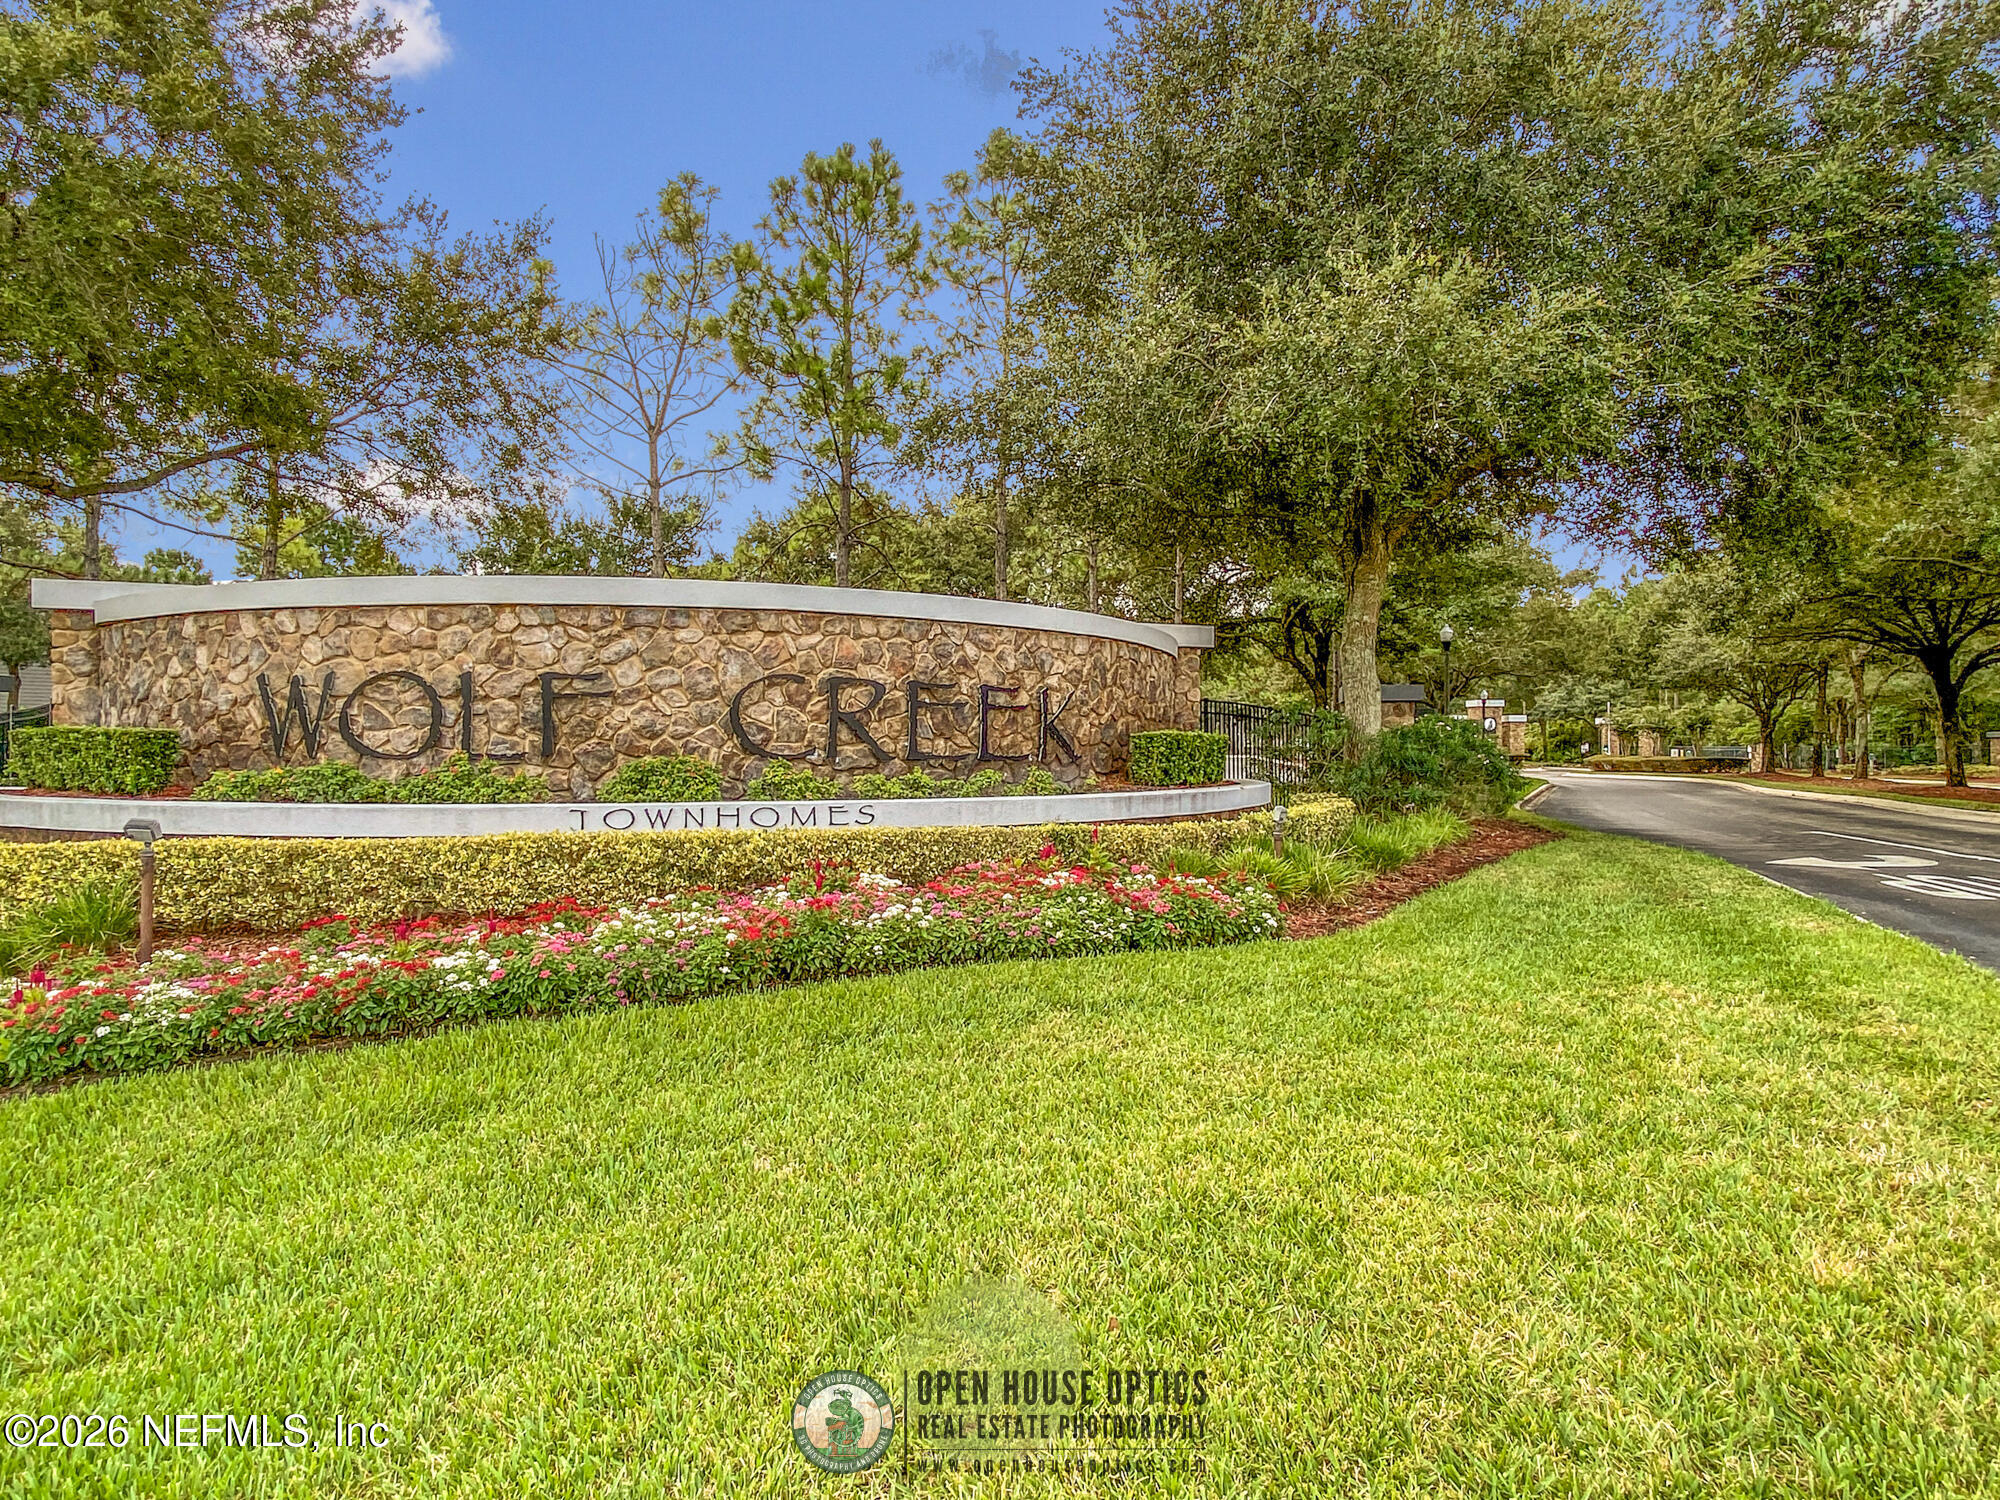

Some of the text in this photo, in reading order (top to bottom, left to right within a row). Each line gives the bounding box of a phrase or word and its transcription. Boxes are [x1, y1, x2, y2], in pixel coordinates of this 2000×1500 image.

[255, 670, 1082, 763] WOLF CREEK
[569, 804, 876, 830] TOWNHOMES
